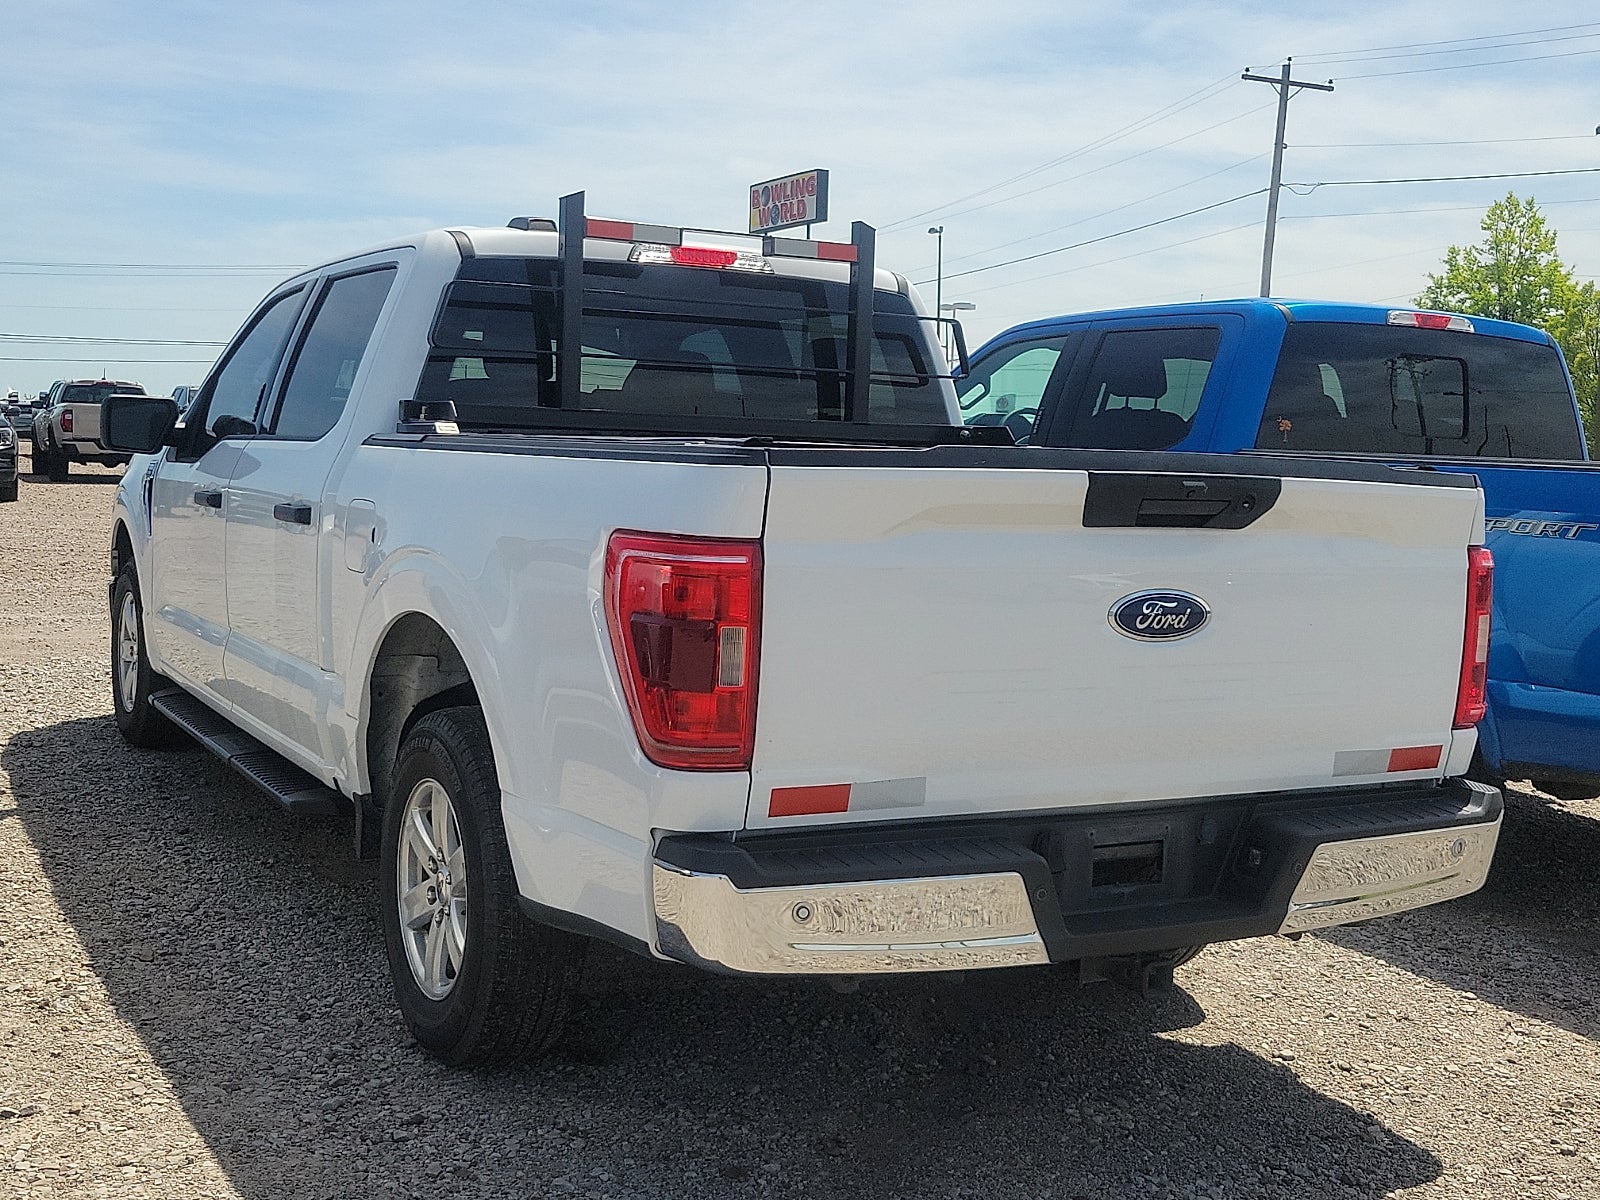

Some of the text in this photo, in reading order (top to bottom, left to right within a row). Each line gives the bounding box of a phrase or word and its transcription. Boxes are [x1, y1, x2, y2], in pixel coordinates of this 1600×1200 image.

[752, 175, 816, 210] BOWLING
[758, 199, 808, 227] WORLD
[1484, 516, 1599, 540] PORT
[1135, 600, 1191, 629] Ford
